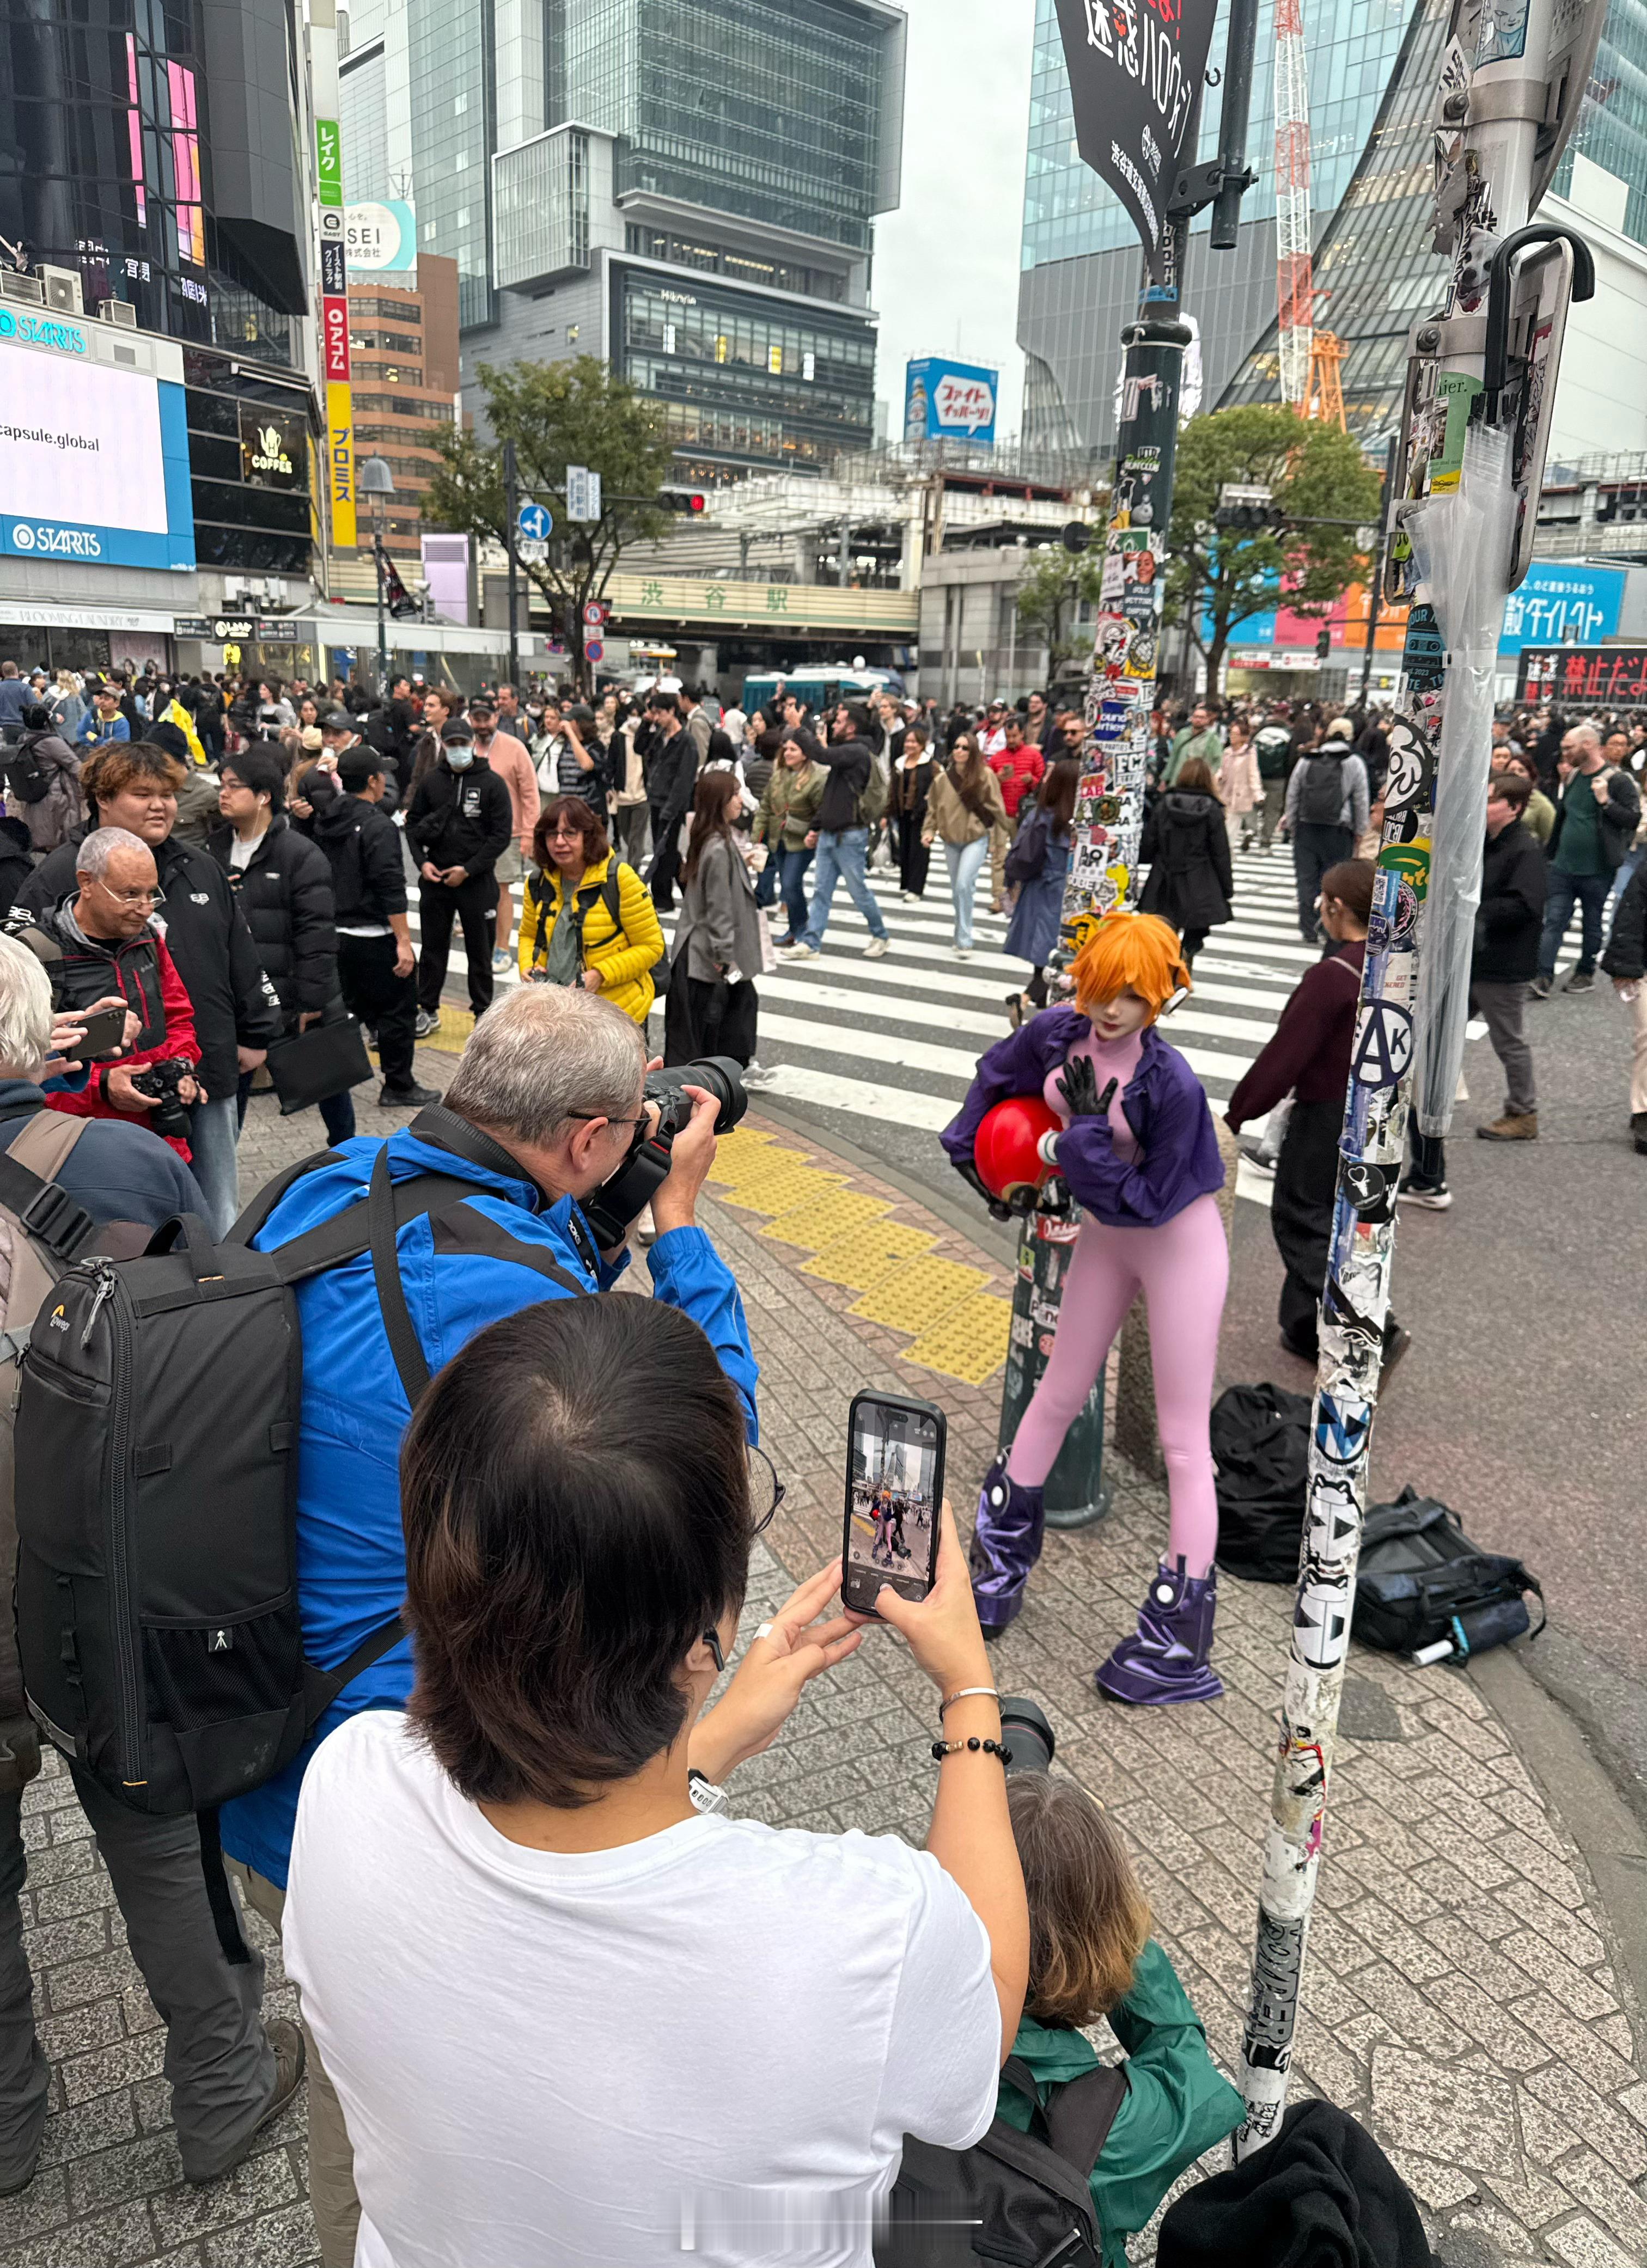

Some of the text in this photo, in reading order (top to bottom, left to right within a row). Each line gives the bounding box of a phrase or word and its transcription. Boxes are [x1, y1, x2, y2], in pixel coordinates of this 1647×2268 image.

[321, 127, 334, 171] レイク
[347, 228, 380, 244] SEI
[325, 249, 333, 284] クリニック
[19, 315, 86, 353] STARTS
[330, 327, 345, 370] アコム
[333, 428, 351, 502] プロミス
[36, 527, 101, 557] STARTS
[641, 581, 789, 612] 渋谷駅
